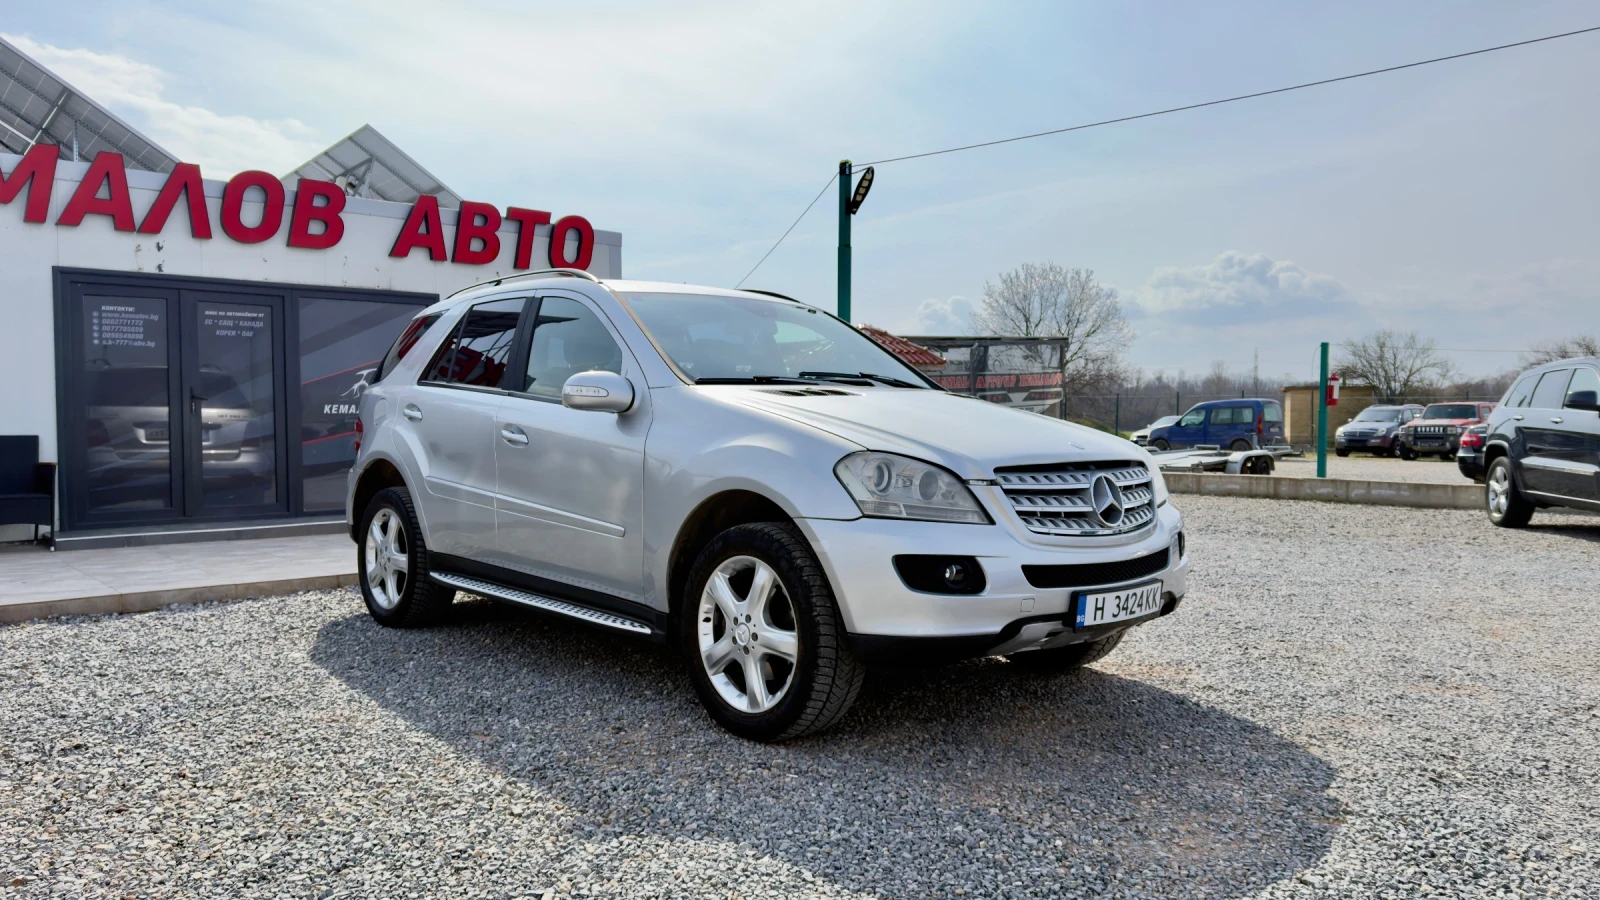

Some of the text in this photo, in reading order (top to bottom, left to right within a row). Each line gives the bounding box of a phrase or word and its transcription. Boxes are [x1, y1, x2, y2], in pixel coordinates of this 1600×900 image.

[389, 194, 596, 270] АВТО
[218, 319, 234, 327] САЩ
[239, 320, 264, 328] КАНАДА
[1093, 597, 1106, 622] H
